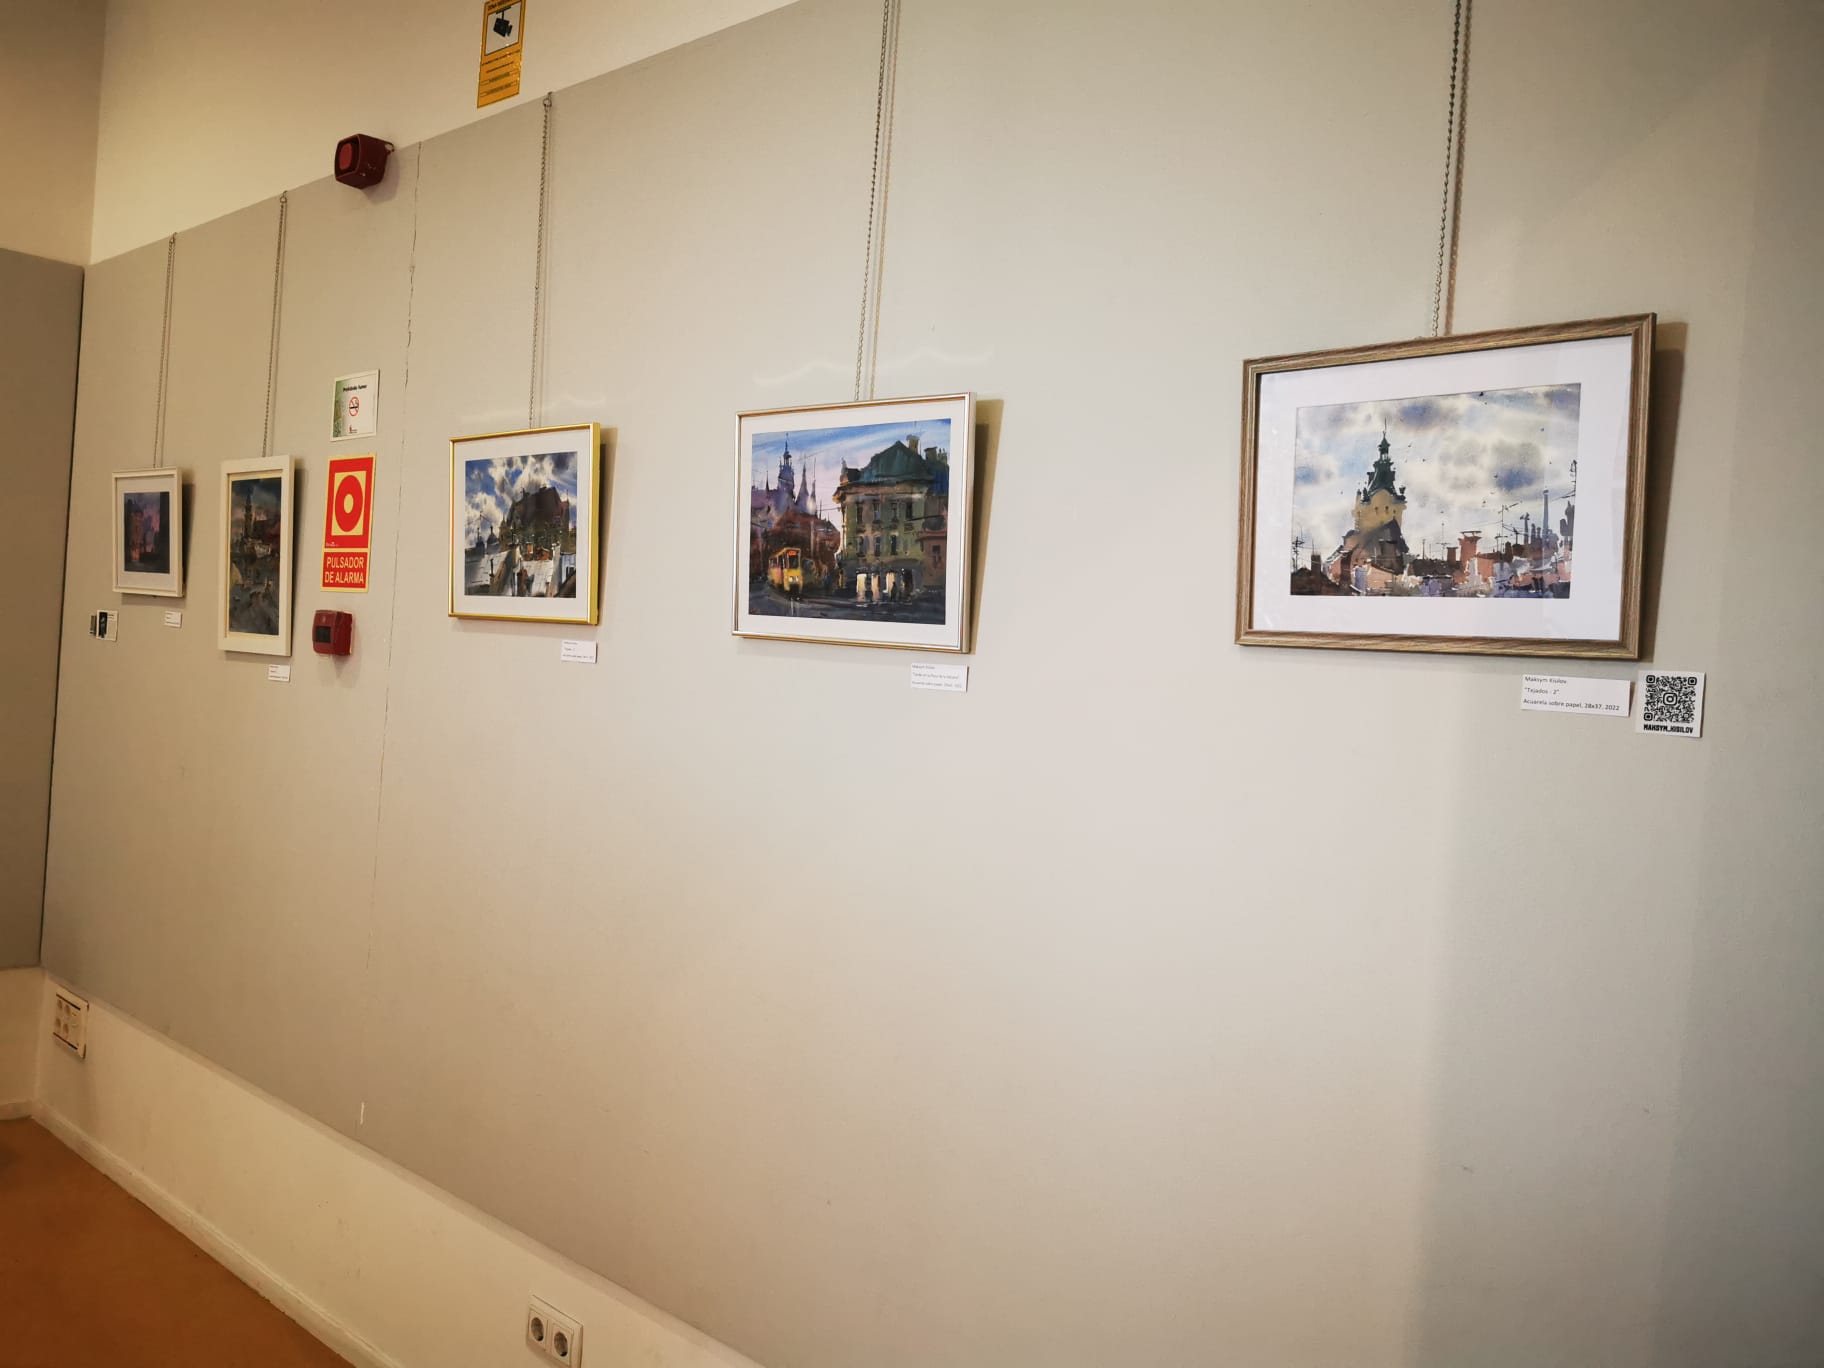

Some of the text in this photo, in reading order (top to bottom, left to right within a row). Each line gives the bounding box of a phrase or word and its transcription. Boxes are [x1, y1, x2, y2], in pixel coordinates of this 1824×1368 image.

[326, 556, 364, 569] PULSADOR
[324, 571, 364, 584] DE ALARMA
